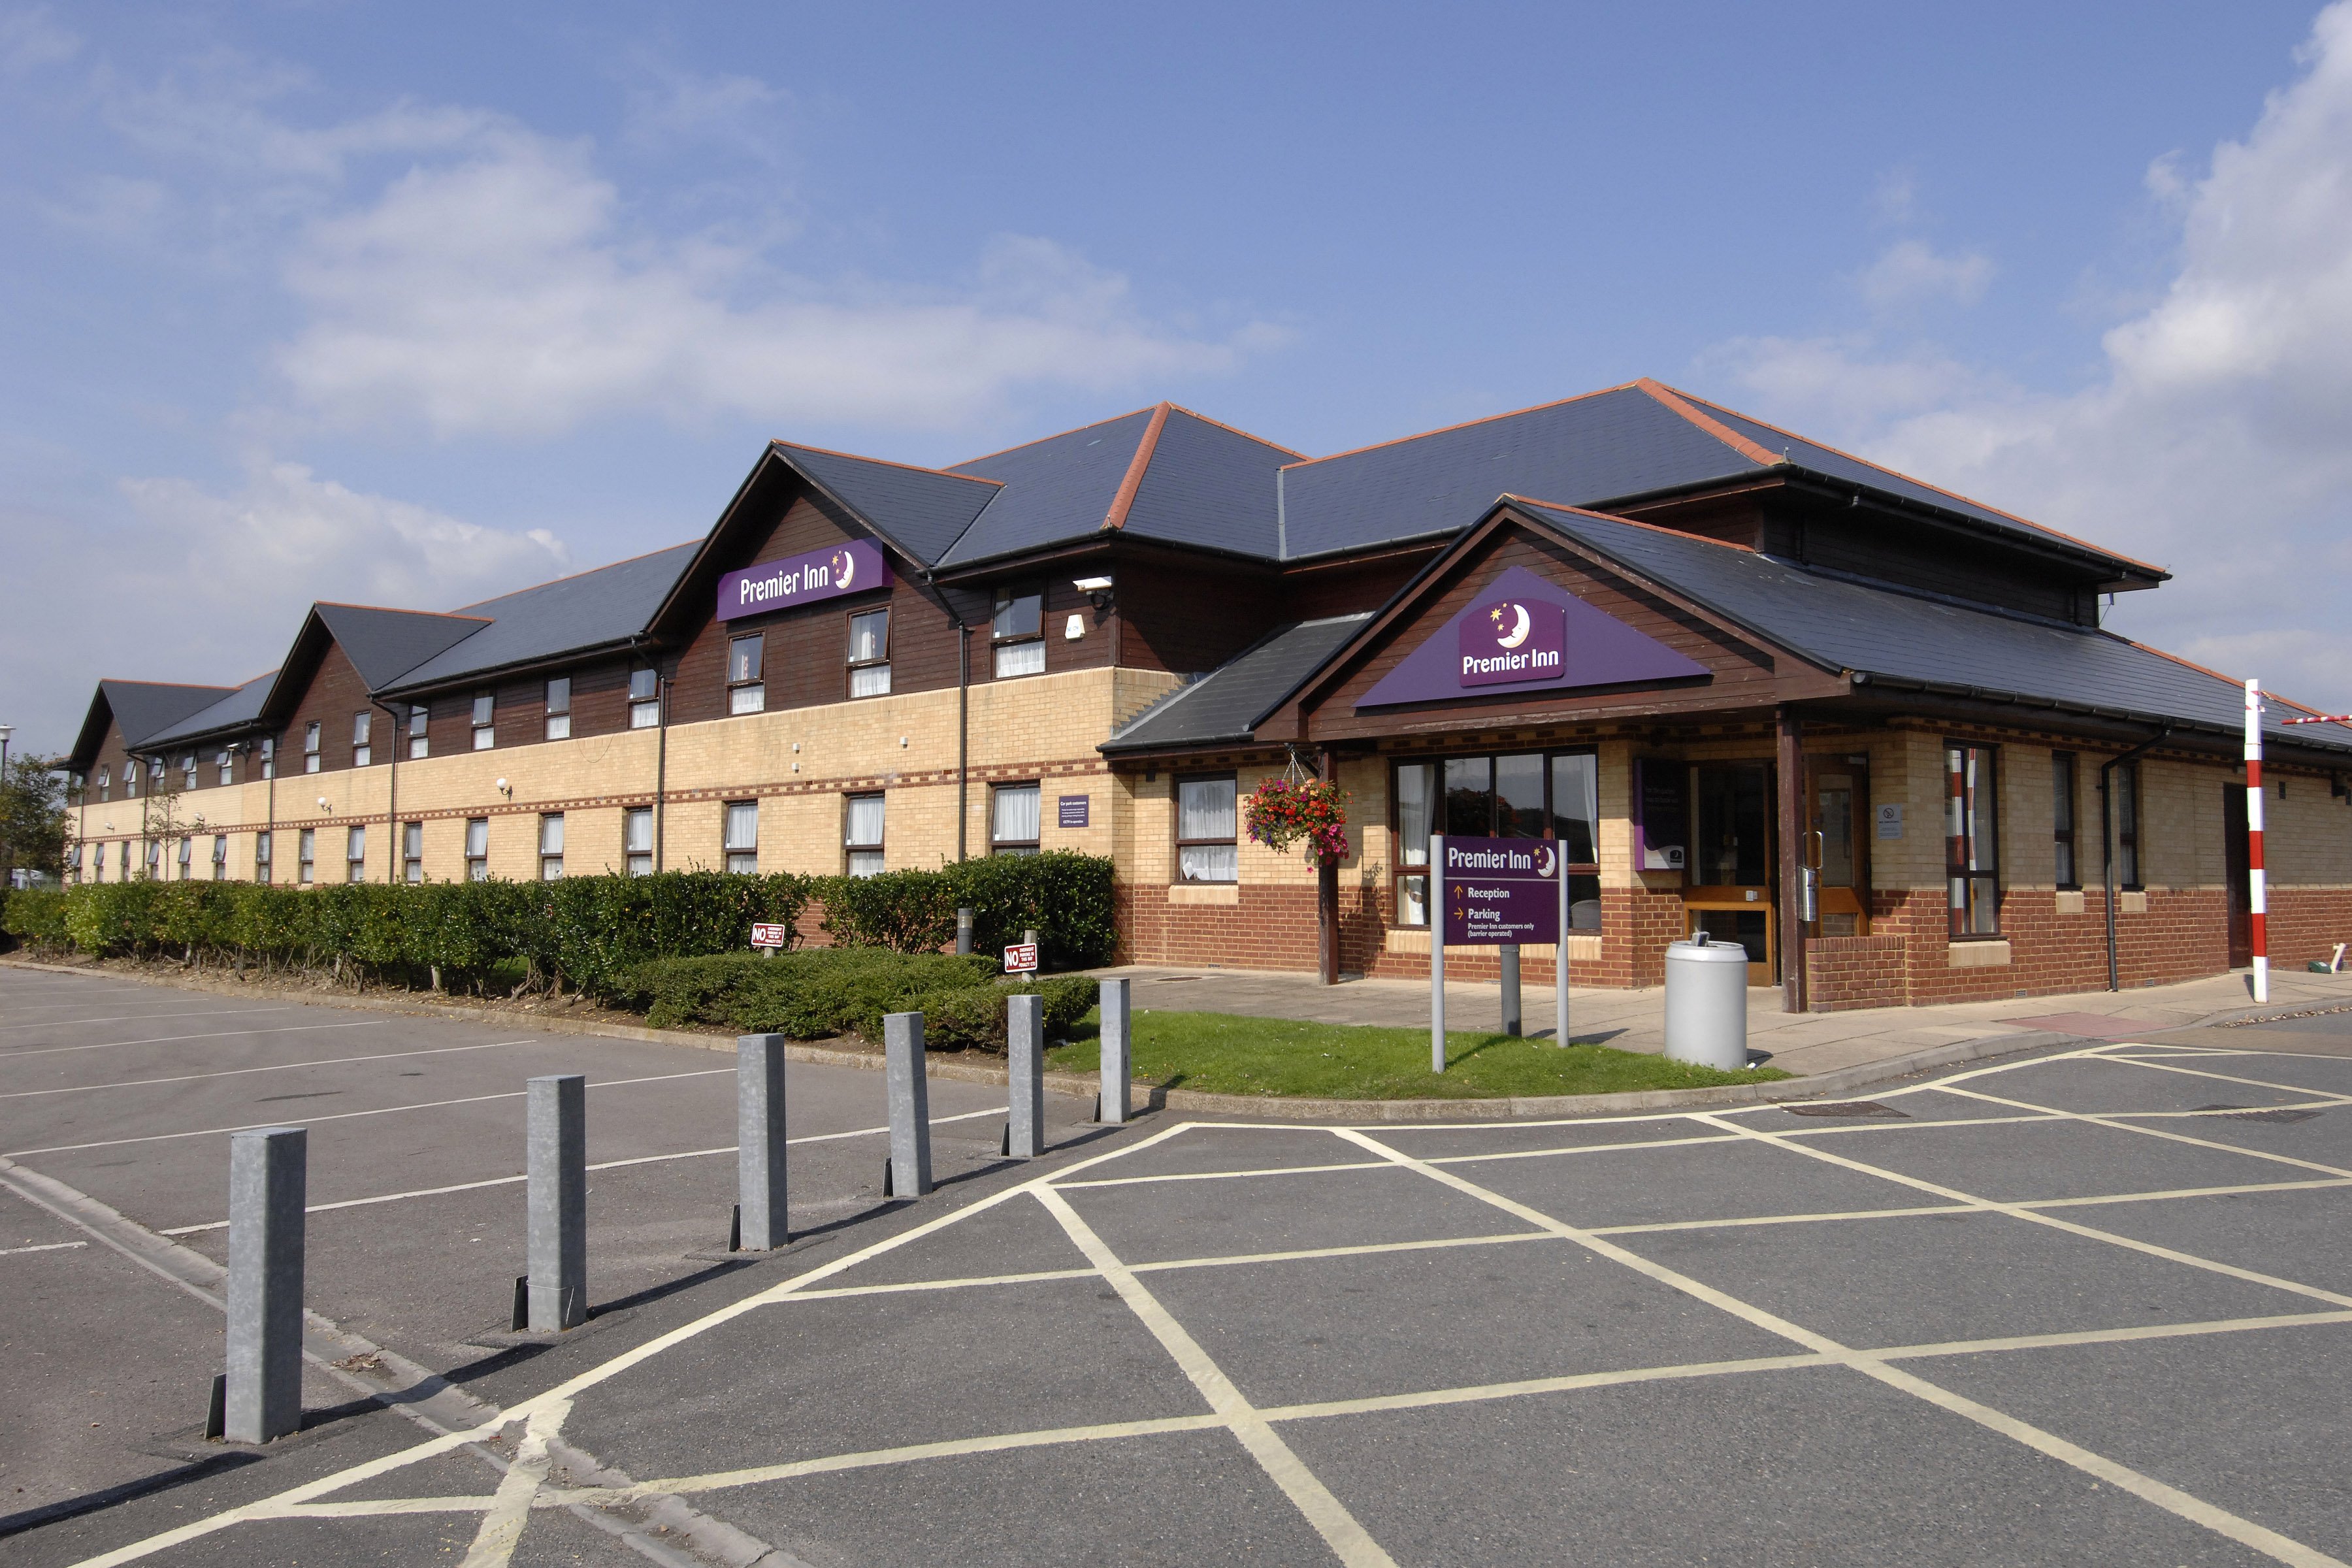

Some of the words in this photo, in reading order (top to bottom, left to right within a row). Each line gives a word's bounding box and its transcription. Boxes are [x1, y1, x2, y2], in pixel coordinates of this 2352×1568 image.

[740, 570, 800, 605] Premier
[804, 564, 828, 591] Inn
[1463, 651, 1528, 675] Premier
[1531, 649, 1559, 668] Inn
[1448, 847, 1507, 868] Premier
[1509, 849, 1531, 870] Inn
[1468, 887, 1510, 901] Reception
[1468, 909, 1501, 922] Parking
[753, 928, 766, 941] NO
[1006, 951, 1019, 966] NO
